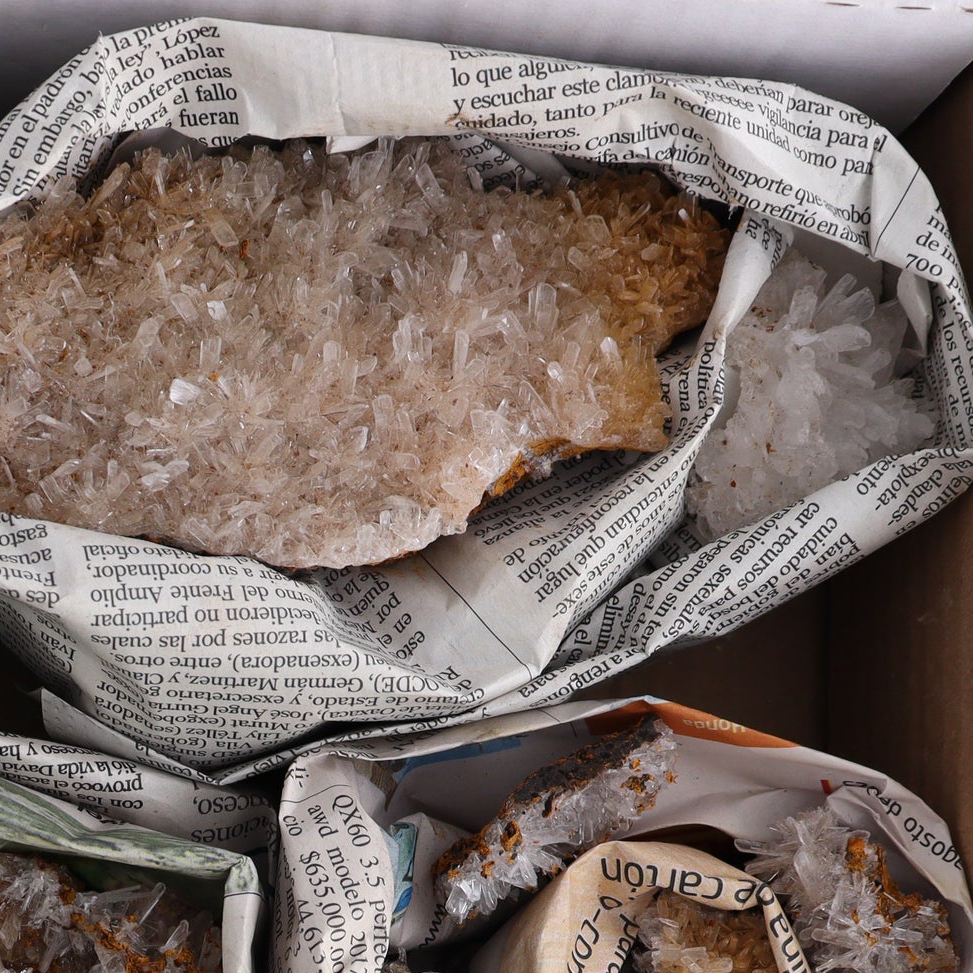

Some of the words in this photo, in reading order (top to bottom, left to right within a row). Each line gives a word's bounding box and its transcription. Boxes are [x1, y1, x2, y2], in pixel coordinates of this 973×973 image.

[163, 24, 221, 51] López
[161, 43, 226, 71] hablar
[450, 67, 471, 87] lo
[475, 66, 513, 88] que
[173, 82, 191, 105] el
[194, 82, 238, 103] fallo
[470, 83, 557, 110] escuchar
[561, 78, 600, 98] este
[9, 135, 29, 160] en
[21, 114, 39, 133] el
[35, 58, 83, 119] padrón
[178, 106, 240, 128] fueran
[785, 97, 835, 117] parar
[544, 103, 596, 122] tanto
[649, 85, 666, 100] la
[672, 95, 741, 129] reciente
[746, 120, 797, 153] unidad
[793, 147, 837, 169] como
[584, 121, 680, 151] Consultivo
[681, 126, 704, 143] de
[12, 168, 40, 203] Sin
[33, 90, 93, 166] embargo,
[825, 129, 869, 149] para
[761, 202, 817, 228] refirió
[816, 220, 839, 237] en
[648, 455, 669, 472] en
[631, 471, 655, 486] la
[794, 502, 820, 529] car
[82, 544, 140, 562] oficial
[779, 517, 838, 576] cuidado
[814, 532, 857, 568] bían
[216, 564, 239, 576] su
[672, 532, 731, 593] pegaron
[739, 527, 800, 590] recursos
[86, 563, 212, 582] coordinador,
[242, 567, 254, 578] a
[90, 580, 163, 608] Amplio
[170, 584, 235, 602] Frente
[241, 584, 269, 602] del
[752, 575, 779, 602] del
[194, 608, 220, 623] no
[654, 592, 678, 618] sin
[697, 586, 737, 626] para
[90, 606, 189, 630] participar
[88, 634, 153, 653] cuales
[158, 635, 186, 653] las
[191, 628, 227, 648] por
[232, 630, 308, 646] razones
[107, 652, 165, 669] otros.
[169, 656, 222, 670] entre
[227, 650, 360, 674] (exsenadora),
[58, 761, 94, 780] vida
[282, 815, 305, 837] cio
[331, 794, 371, 847] QX60
[359, 855, 386, 888] 3.5
[307, 804, 339, 839] awd
[326, 846, 367, 921] modelo
